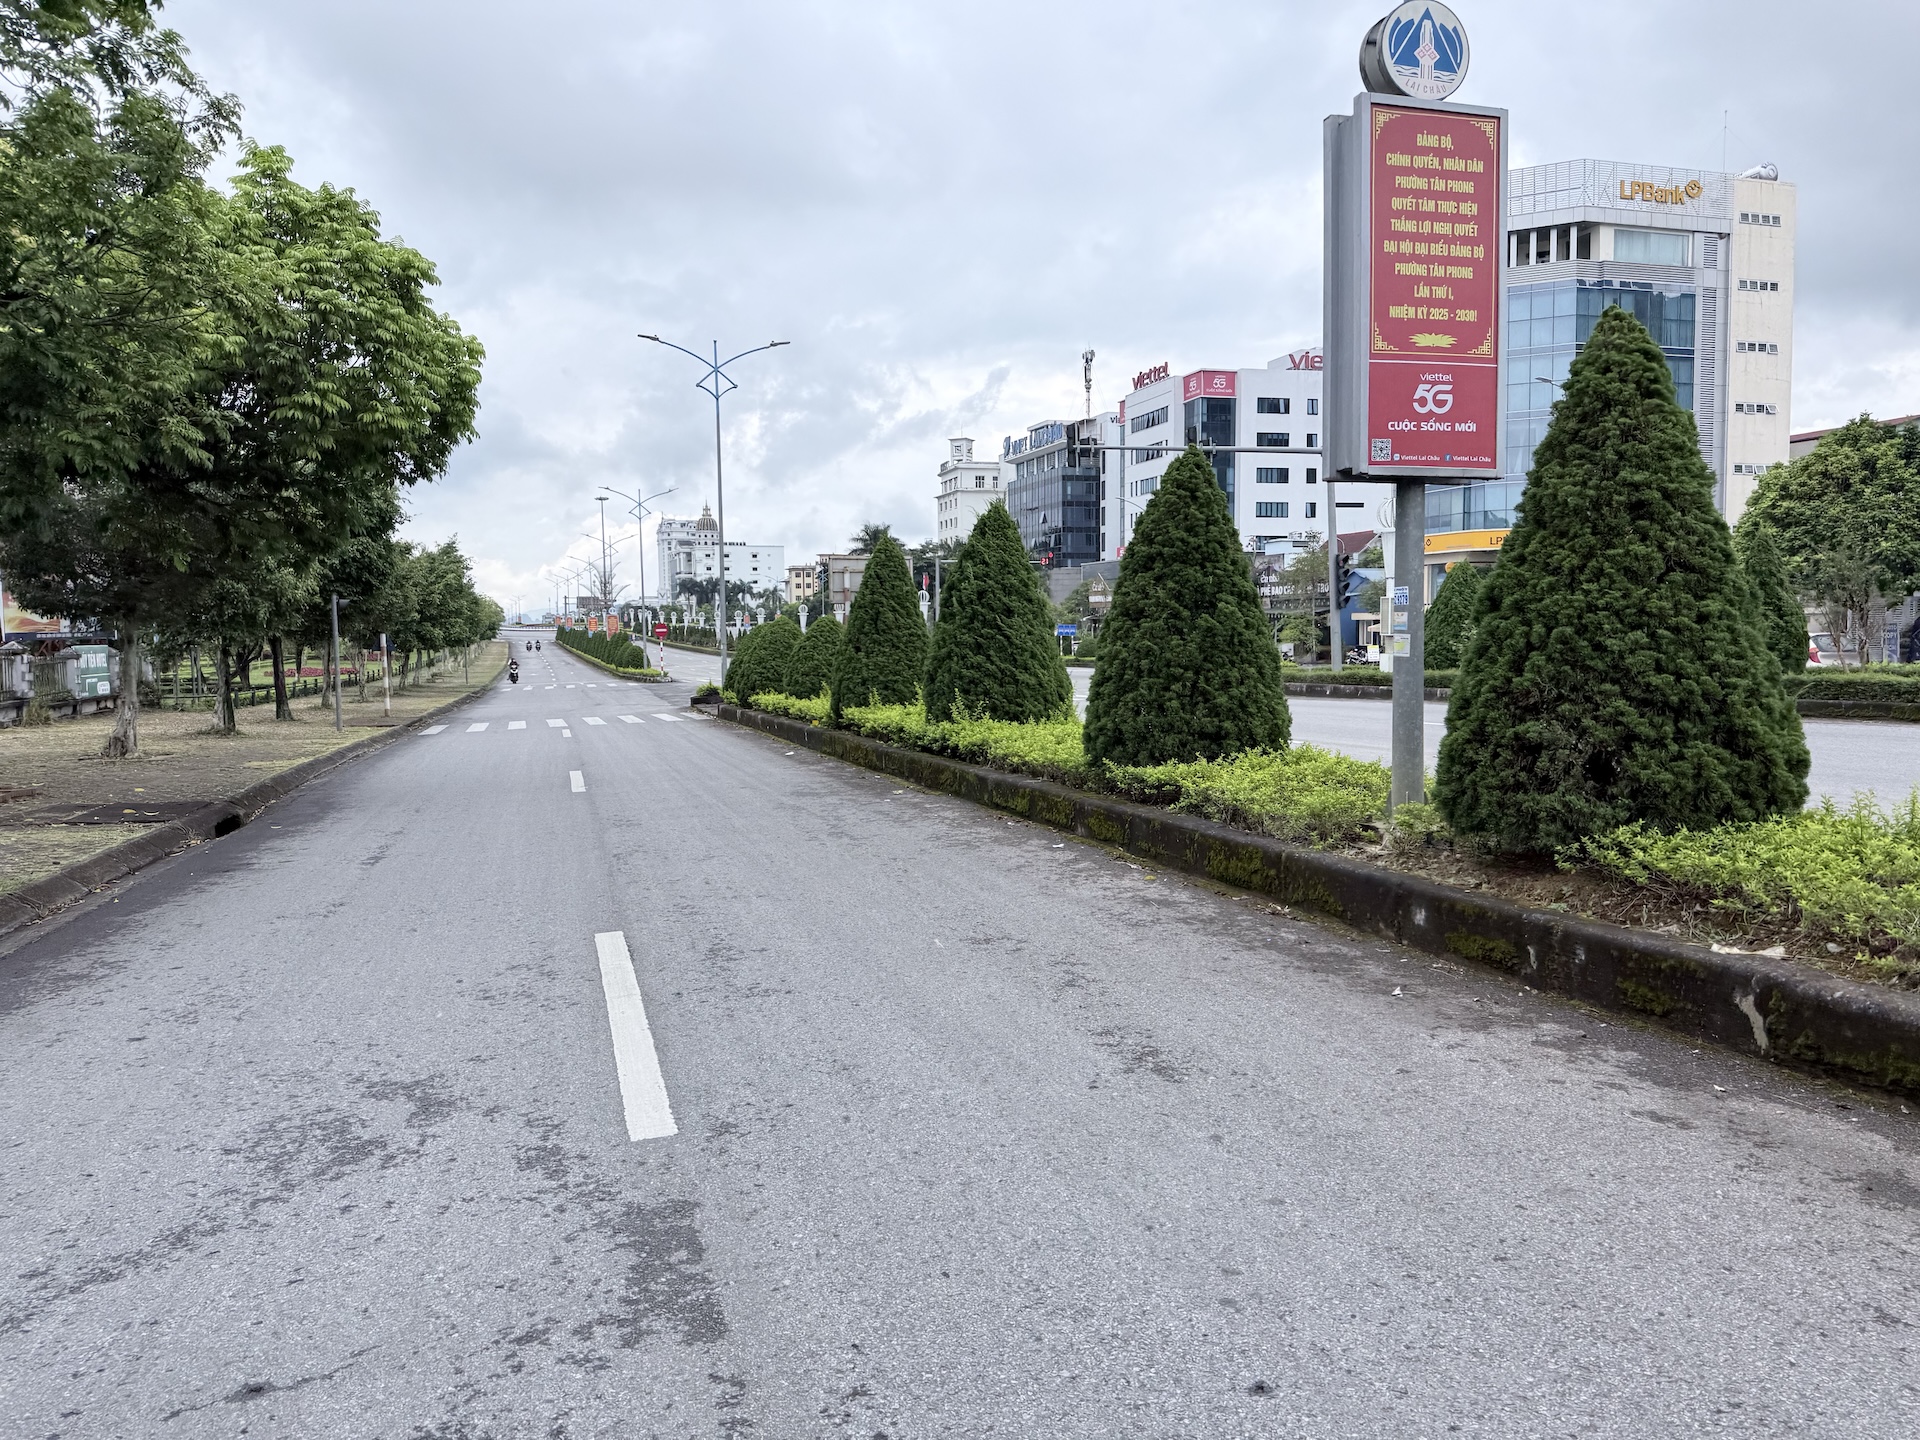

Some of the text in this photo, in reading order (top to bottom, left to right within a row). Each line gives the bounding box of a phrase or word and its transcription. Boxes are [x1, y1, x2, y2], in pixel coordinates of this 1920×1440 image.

[1416, 130, 1454, 151] ĐẢNG BỘ,
[1386, 151, 1411, 167] CHÍNH
[1443, 156, 1465, 172] NHÂN
[1467, 157, 1484, 173] DÂN
[1395, 174, 1475, 194] PHƯỜNG TÂN PHONG
[1620, 179, 1686, 205] LPBank
[1391, 195, 1478, 217] QUYẾT TÂM THỰC HIỆN
[1390, 215, 1478, 238] THẮNG LỢI NGHỊ QUYẾT
[1383, 239, 1484, 261] ĐẠI HỘI ĐẠI BIỂU ĐẢNG BỘ
[1394, 261, 1473, 279] PHƯỜNG TÂN PHONG
[1431, 284, 1447, 299] THỨ
[1389, 304, 1415, 321] NHIỆM
[1417, 305, 1428, 319] KỲ
[1429, 308, 1449, 320] 2025
[1455, 309, 1478, 322] 2030!
[1132, 361, 1169, 391] viettel
[1420, 372, 1453, 382] viettel
[1412, 383, 1454, 414] 5G
[1388, 417, 1477, 433] CUỘC SỐNG MỚI
